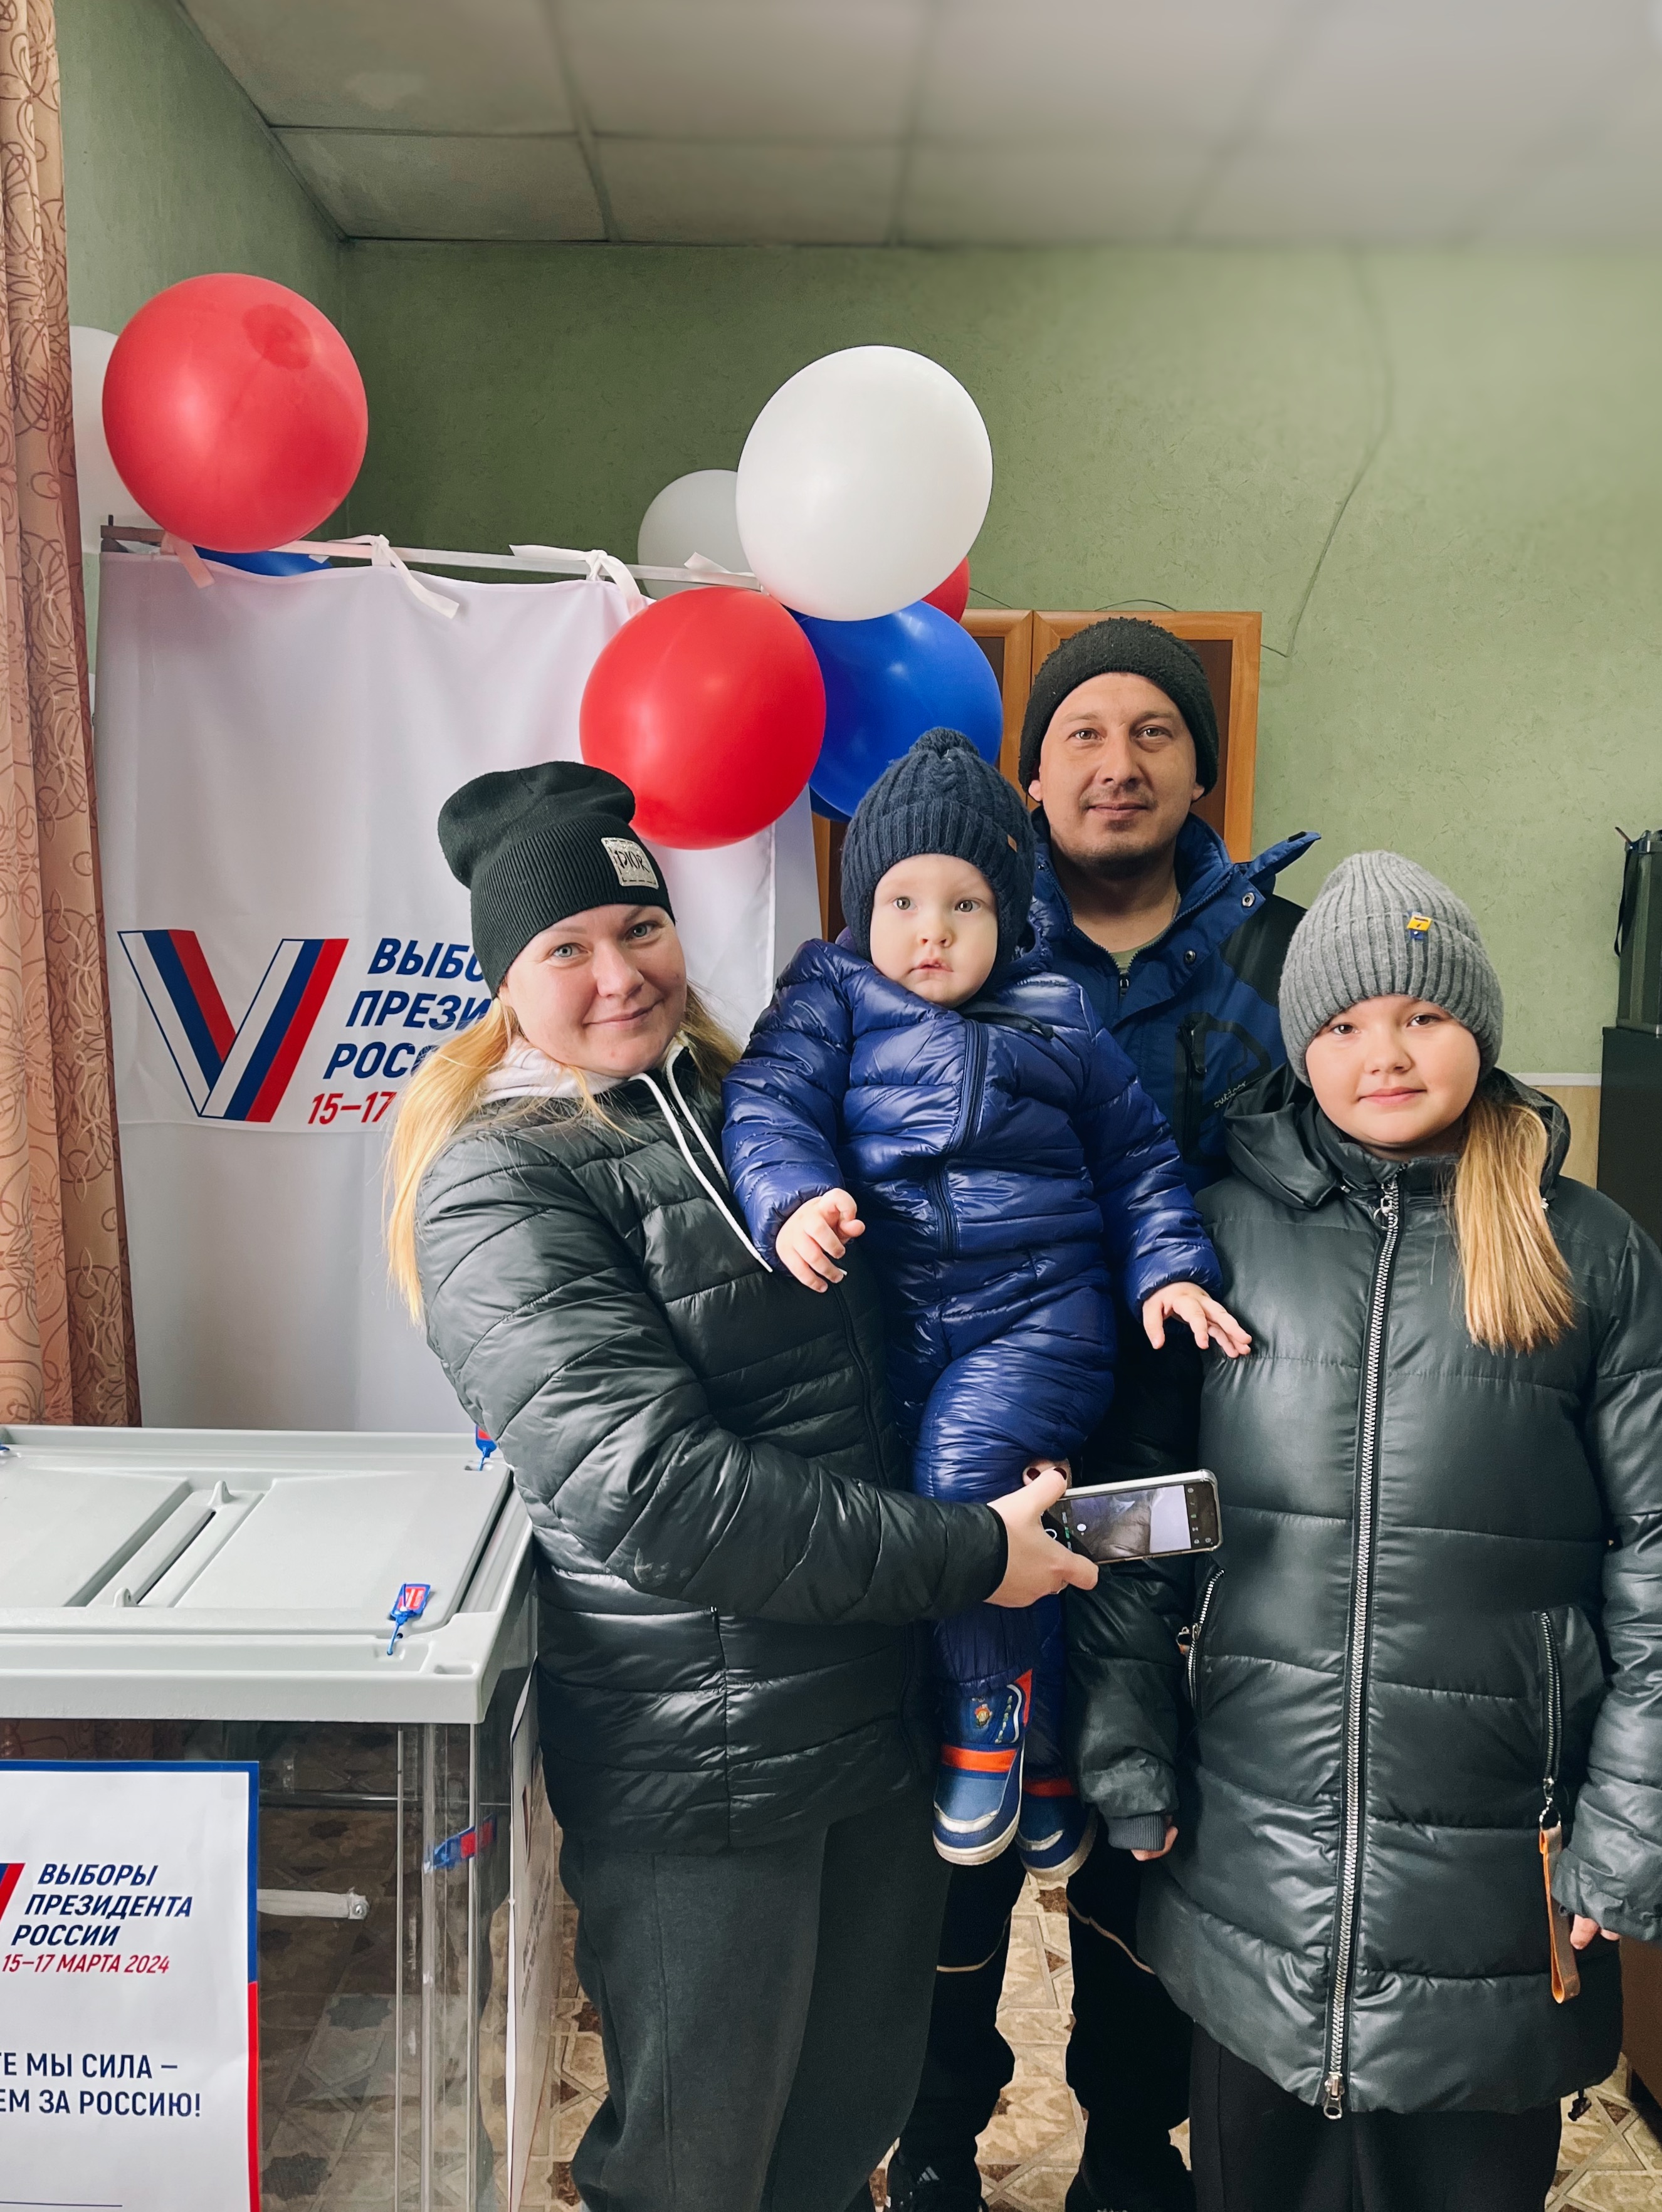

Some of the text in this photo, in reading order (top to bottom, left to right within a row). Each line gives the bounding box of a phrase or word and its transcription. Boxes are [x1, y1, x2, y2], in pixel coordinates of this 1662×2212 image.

[614, 850, 650, 873] DIOR
[345, 990, 492, 1030] ПРЕЗИ
[38, 1863, 158, 1886] ВЫБОРЫ
[24, 1894, 192, 1919] ПРЕЗИДЕНТА
[11, 1924, 120, 1946] РОССИИ
[56, 1954, 121, 1973] МАРТА
[124, 1954, 169, 1974] 2024
[27, 2053, 72, 2077] МЫ
[83, 2053, 152, 2078] СИЛА
[39, 2090, 70, 2114] ЗА
[80, 2091, 200, 2117] РОССИЮ!
